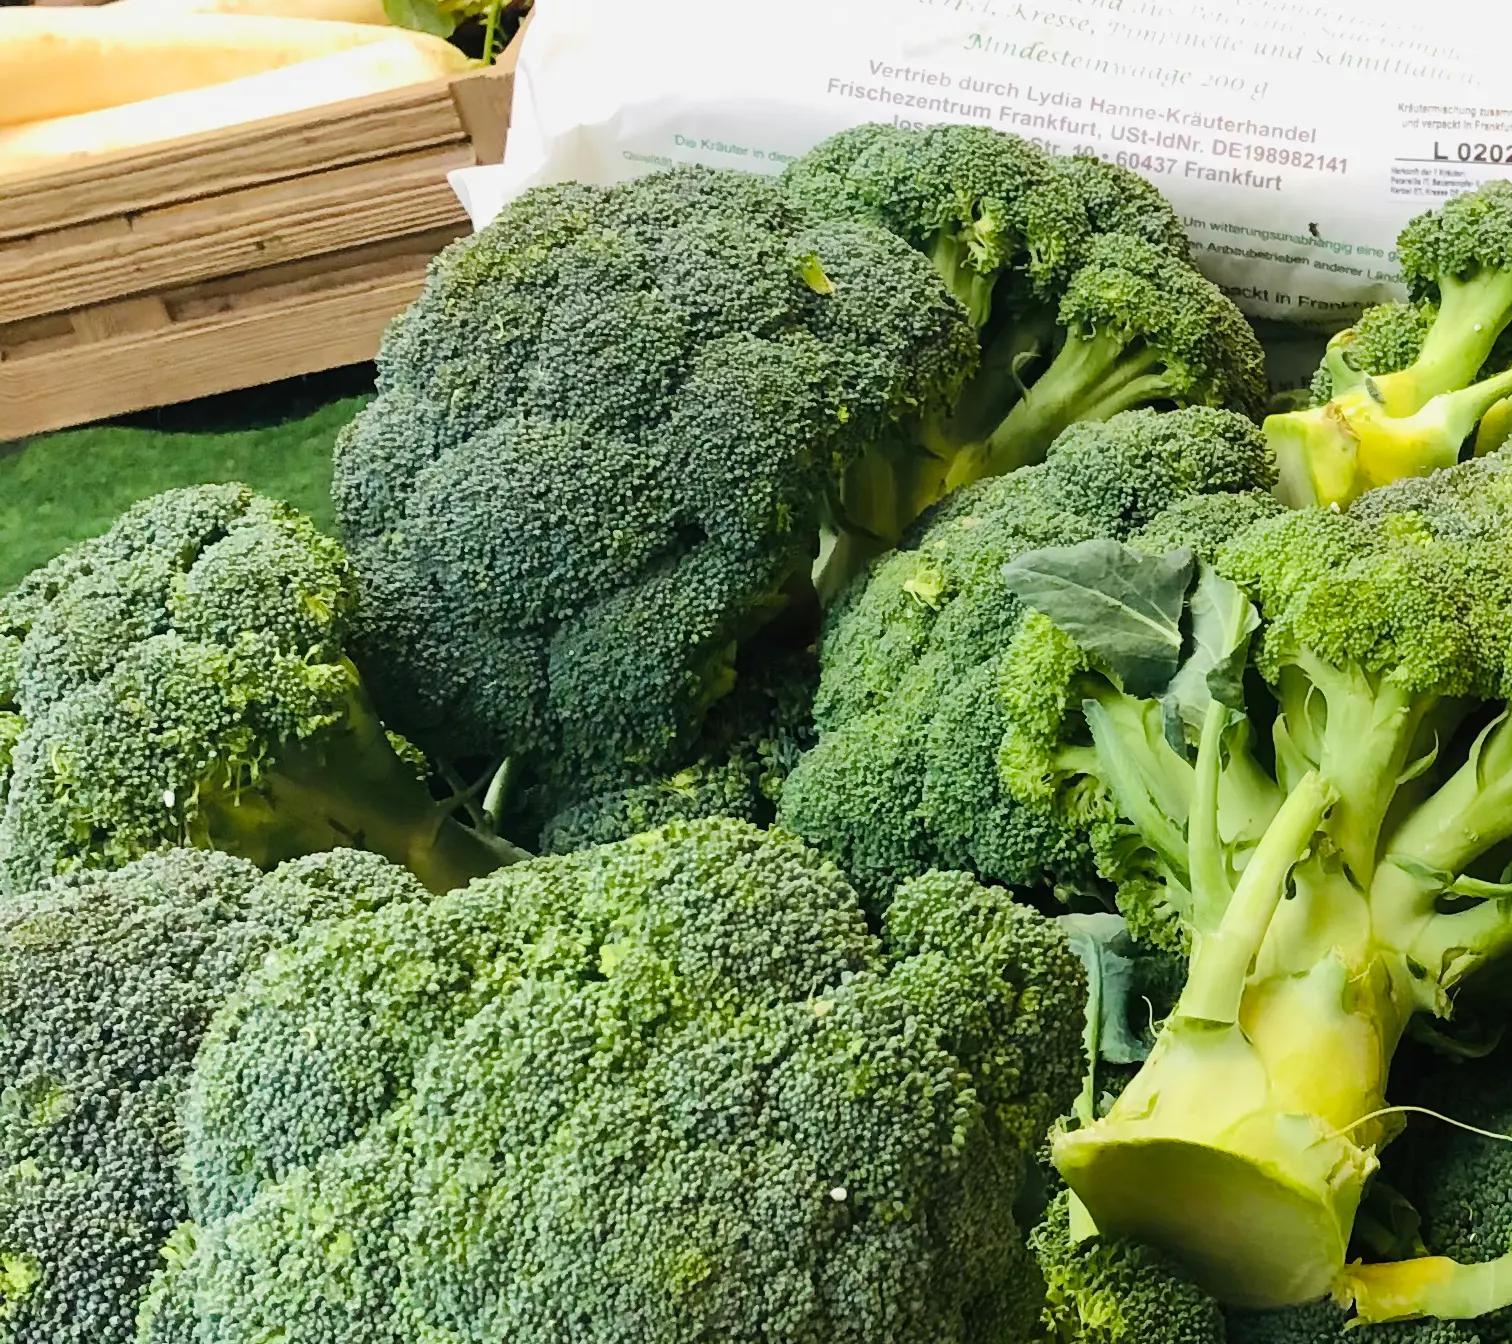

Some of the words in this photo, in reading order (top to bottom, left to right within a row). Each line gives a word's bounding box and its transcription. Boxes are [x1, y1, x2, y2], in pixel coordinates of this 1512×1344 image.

[868, 59, 952, 88] Vertrieb
[958, 74, 1020, 99] durch
[1027, 84, 1083, 114] Lydia
[826, 77, 993, 121] Frischezentrum
[1212, 139, 1349, 176] DE198982141
[1115, 150, 1178, 175] 60437
[1185, 161, 1283, 192] Frankfurt
